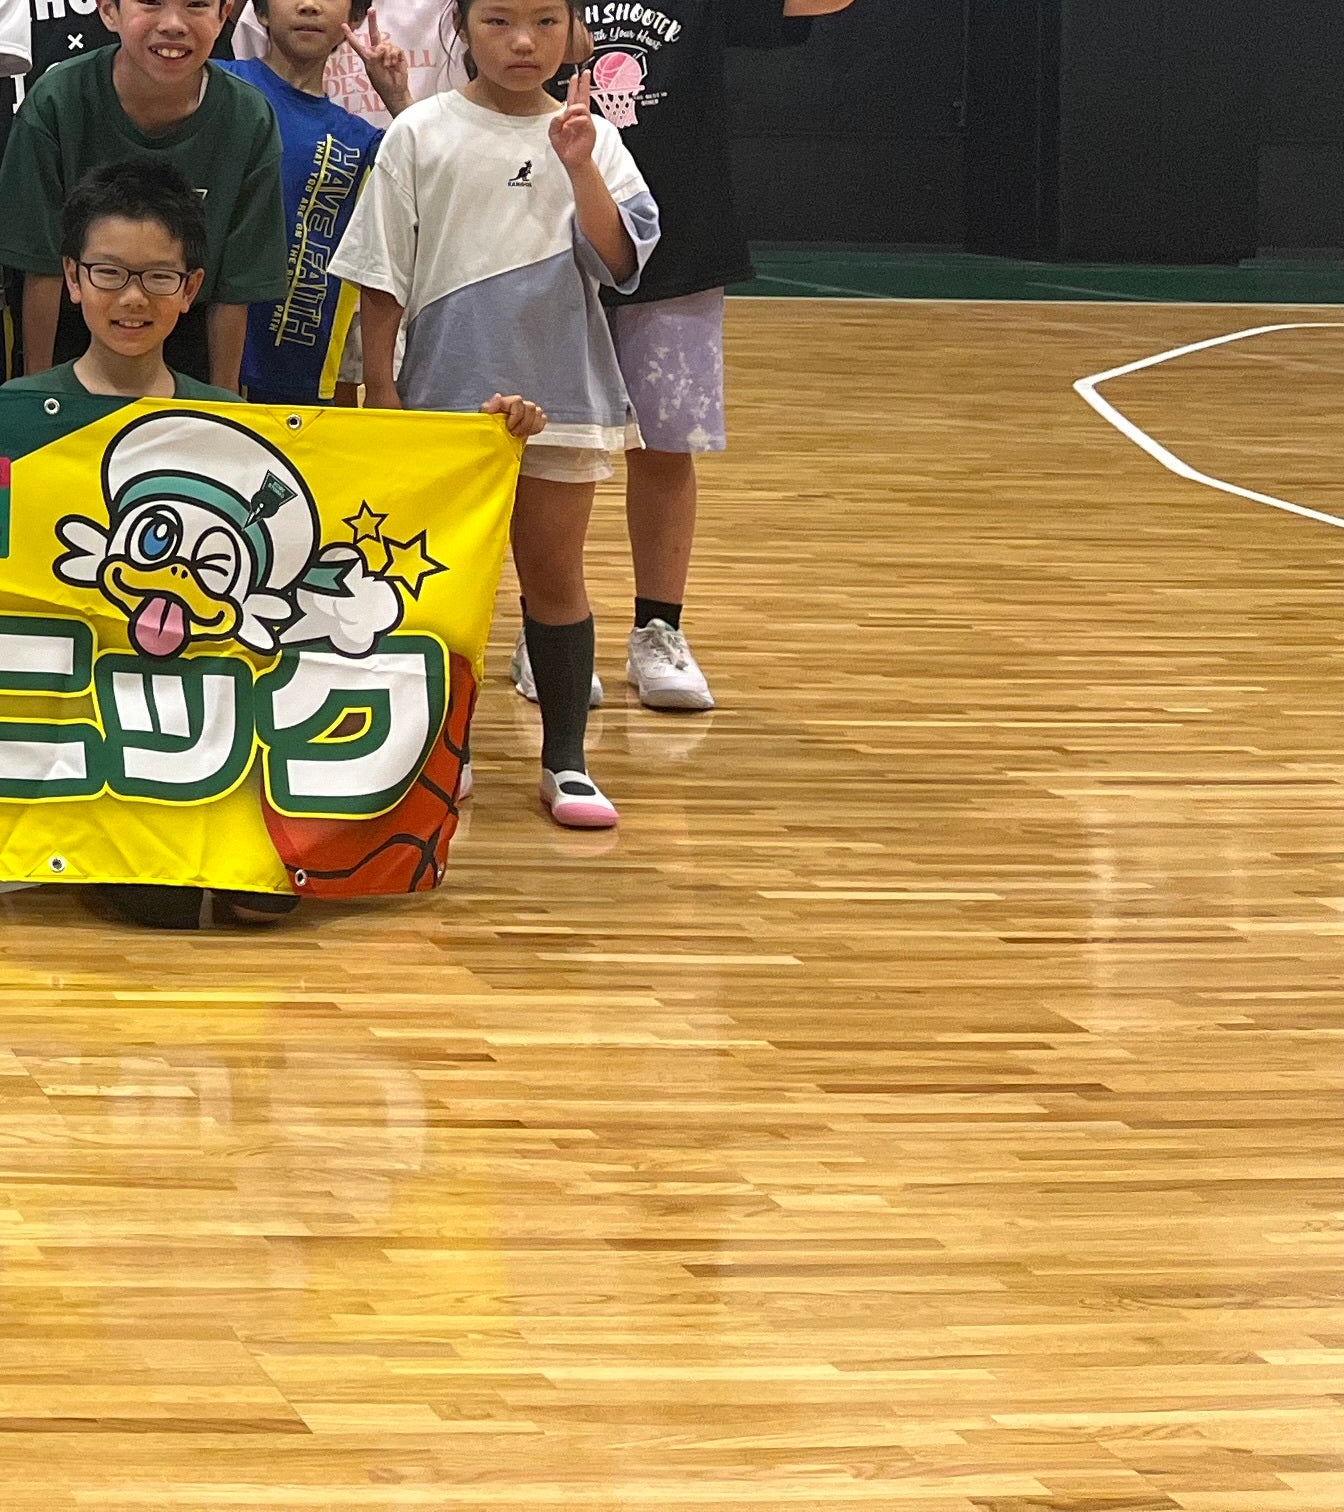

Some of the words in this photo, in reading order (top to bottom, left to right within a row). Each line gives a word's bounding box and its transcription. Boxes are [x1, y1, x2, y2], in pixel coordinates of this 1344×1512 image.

[601, 2, 682, 43] SHOOTER
[309, 137, 361, 239] HAVE
[269, 304, 284, 332] PATH
